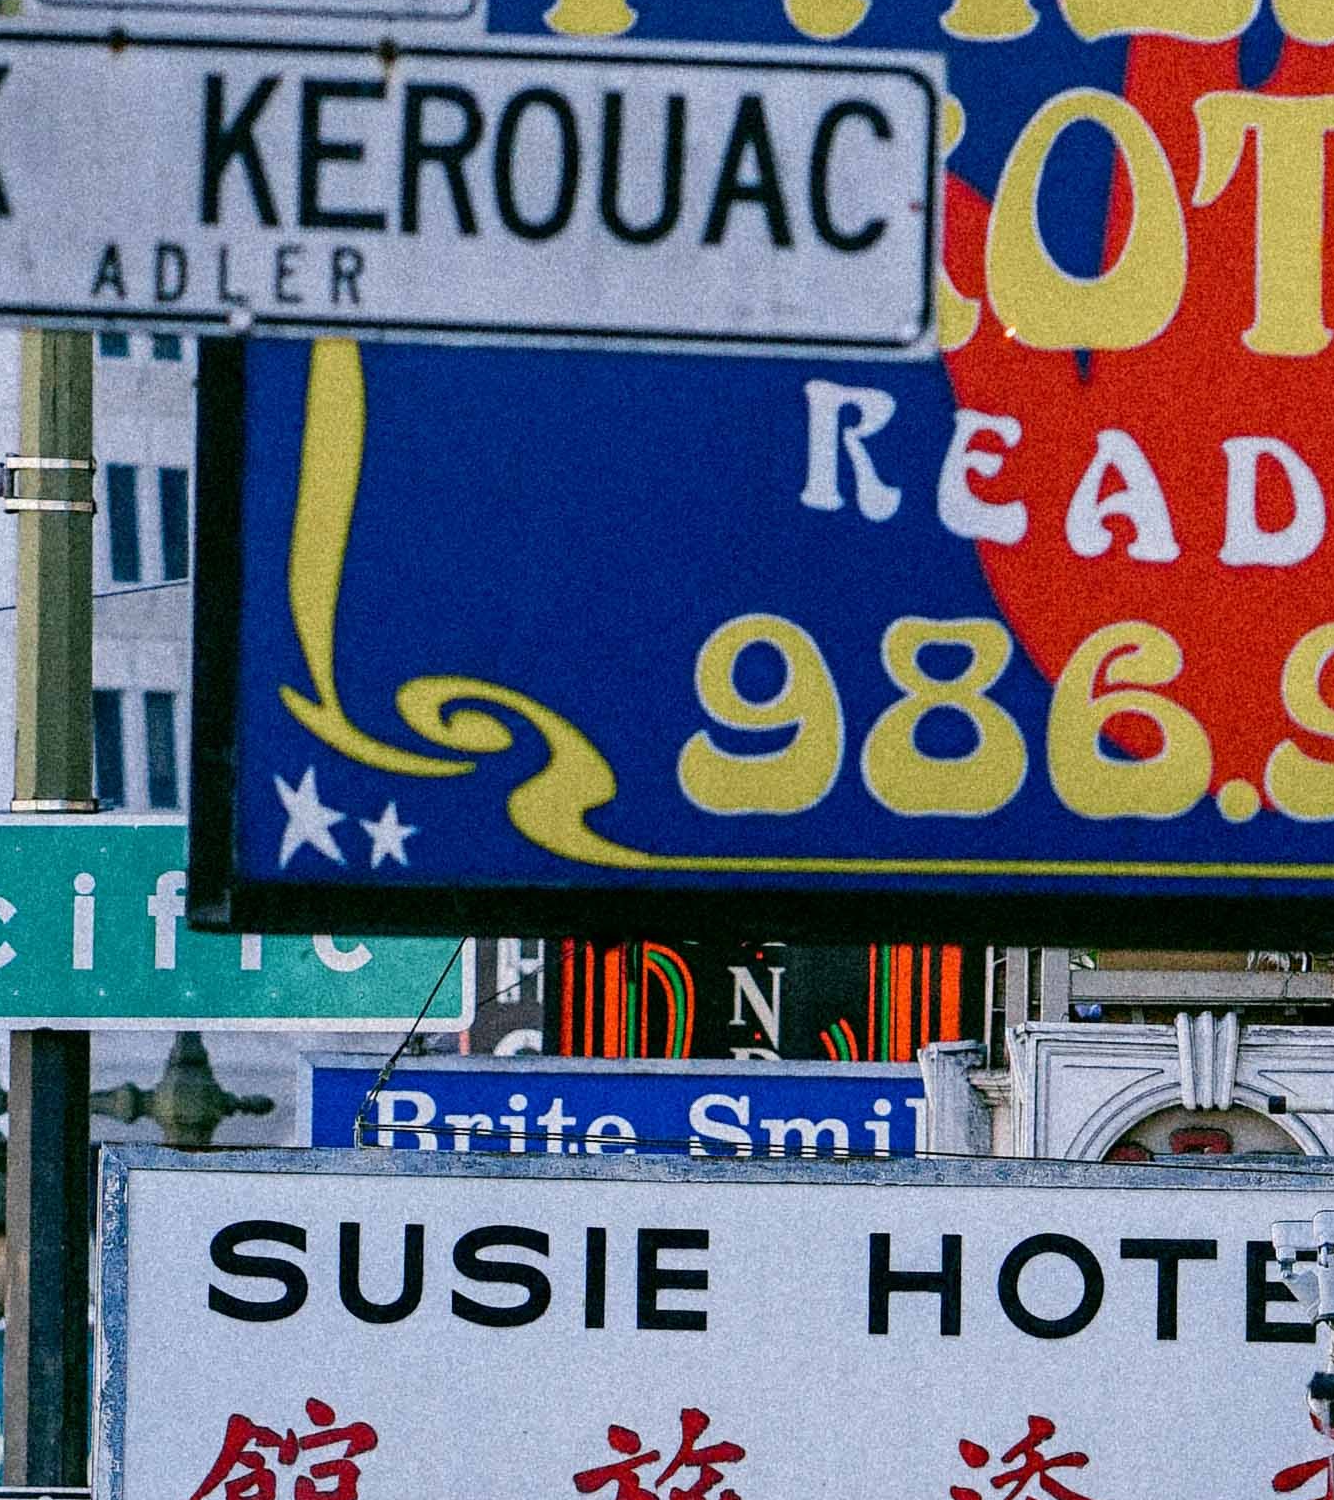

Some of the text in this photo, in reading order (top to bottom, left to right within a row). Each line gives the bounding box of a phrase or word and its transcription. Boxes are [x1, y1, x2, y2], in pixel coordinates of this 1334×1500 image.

[199, 74, 895, 253] KEROUAC
[91, 244, 365, 306] ADLER
[376, 1090, 637, 1155] Brite
[208, 1220, 710, 1331] SUSIE
